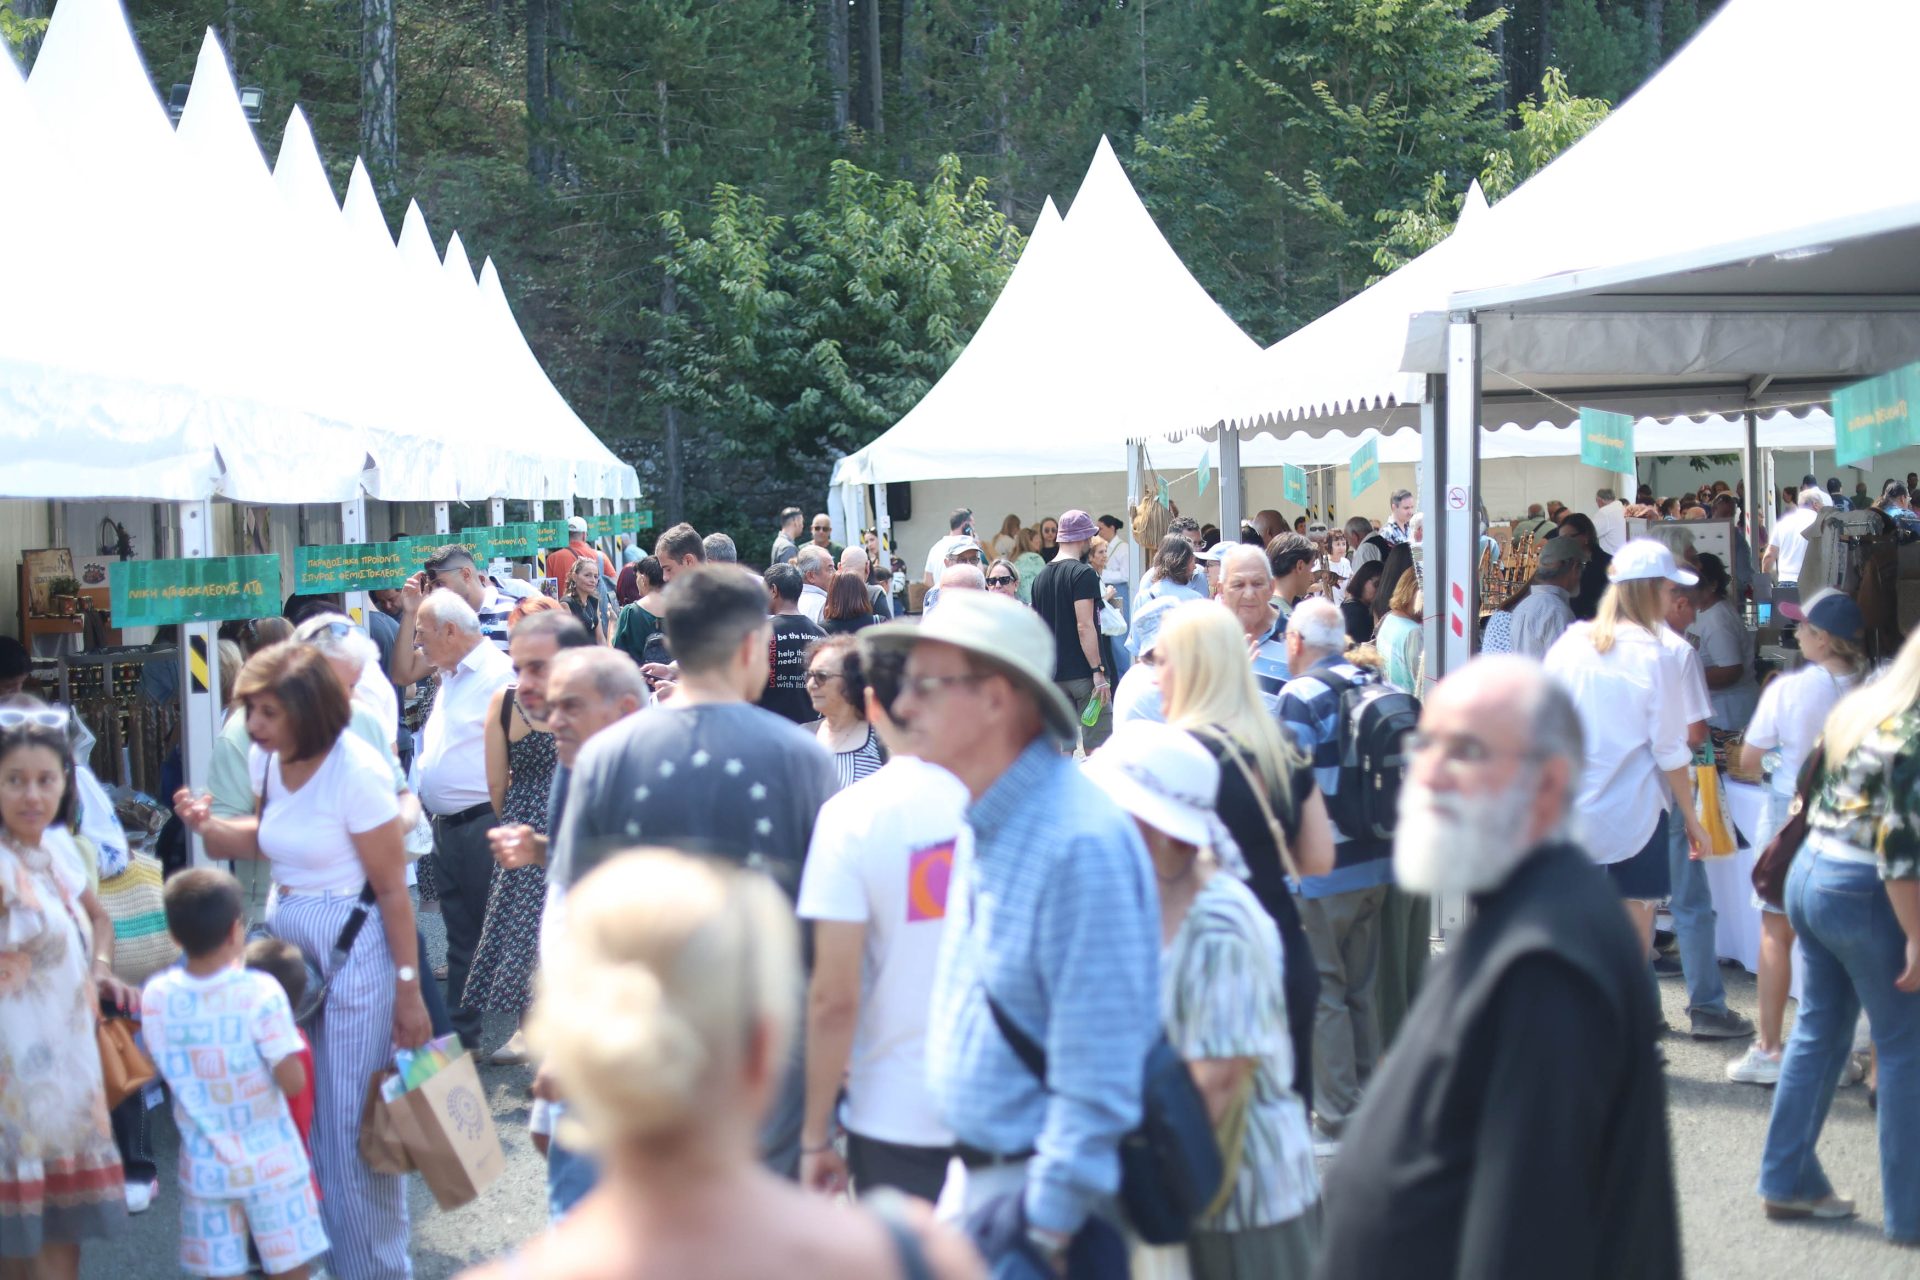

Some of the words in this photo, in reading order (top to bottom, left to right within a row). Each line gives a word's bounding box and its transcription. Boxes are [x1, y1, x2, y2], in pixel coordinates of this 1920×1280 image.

[128, 589, 157, 599] ΝΙΚΗ
[243, 580, 264, 596] ΛΤΔ
[788, 632, 800, 640] the
[777, 649, 795, 658] help
[777, 657, 797, 665] need
